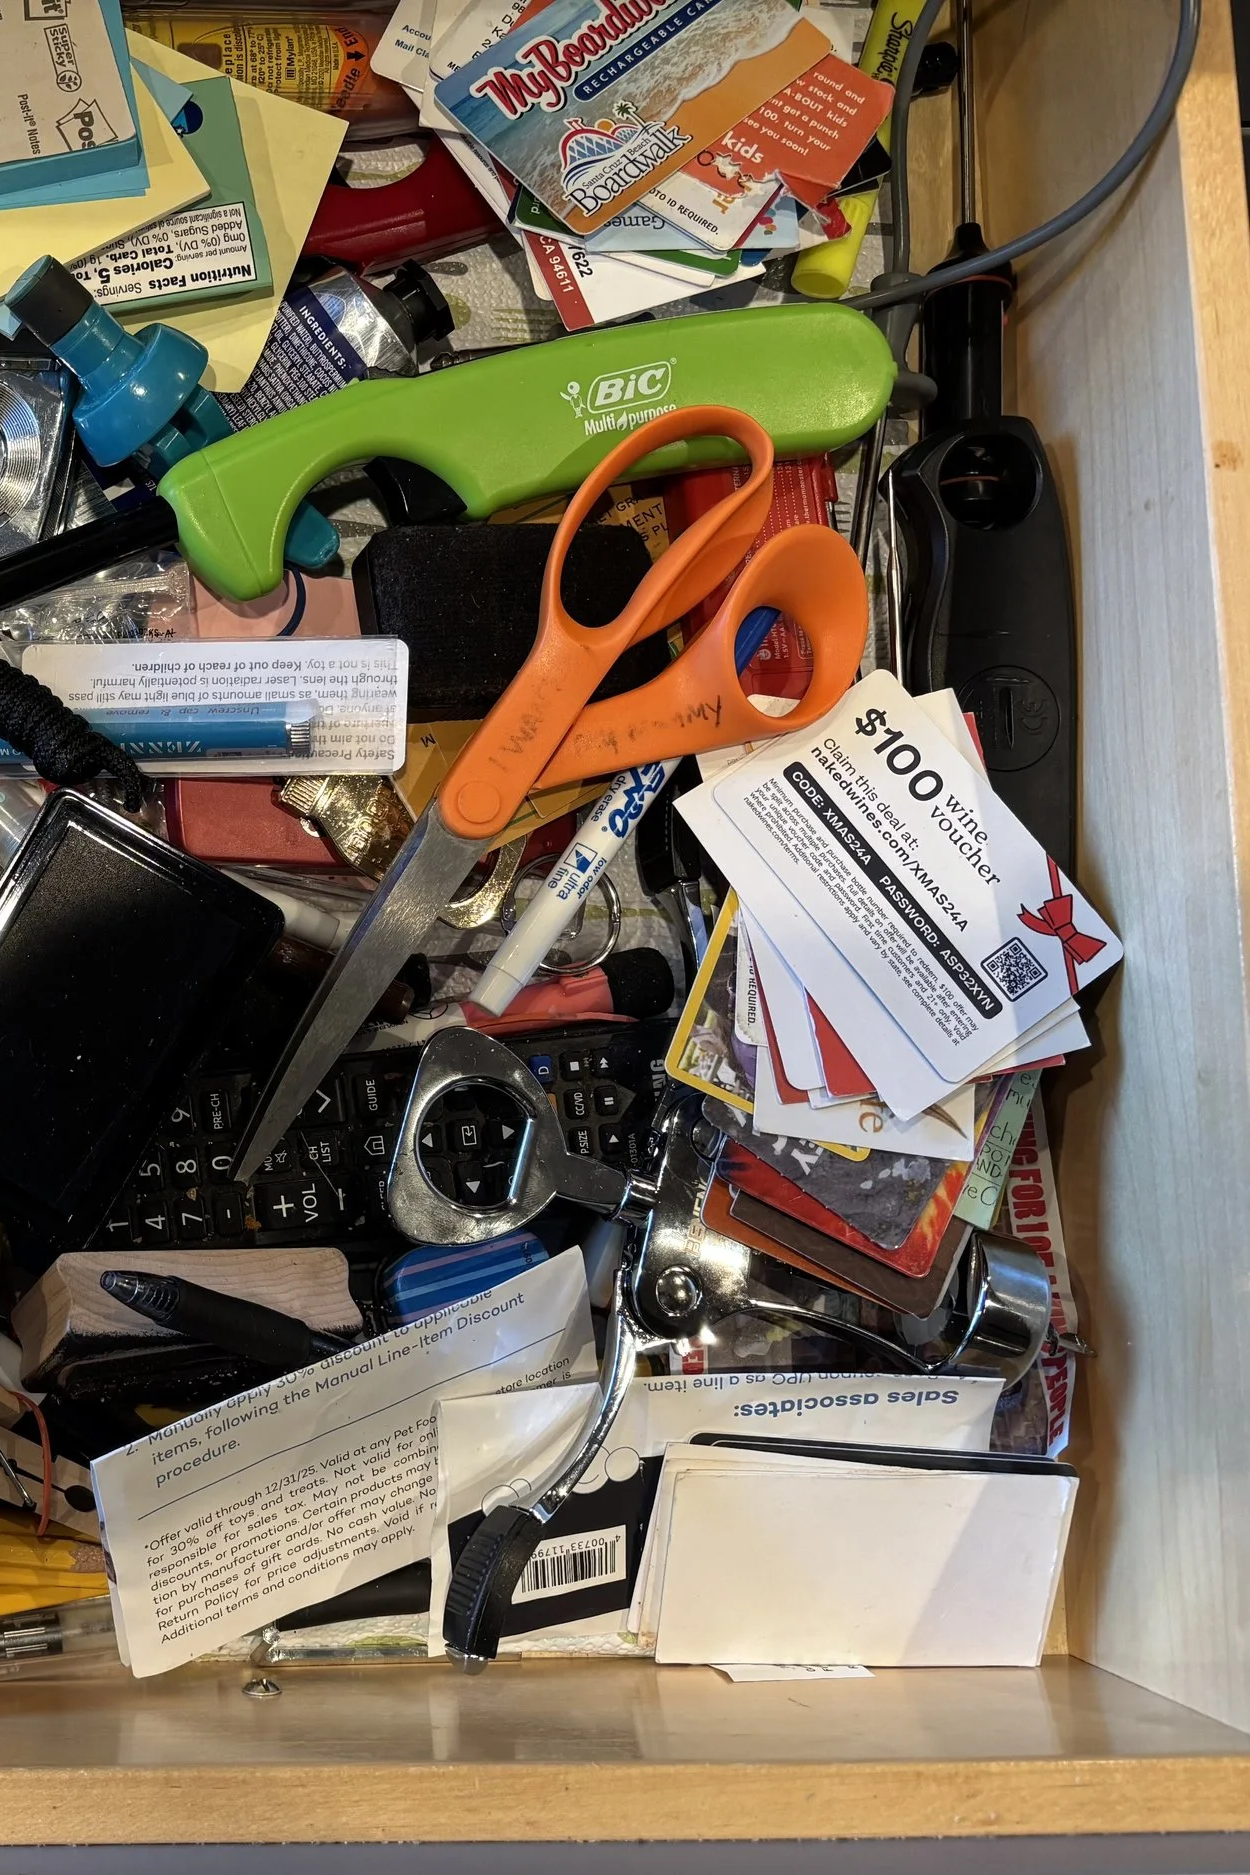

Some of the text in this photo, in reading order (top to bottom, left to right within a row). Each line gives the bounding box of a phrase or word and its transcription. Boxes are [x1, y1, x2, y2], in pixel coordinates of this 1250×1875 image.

[49, 27, 69, 70] Sticky
[54, 25, 77, 67] Super
[582, 17, 682, 93] RECHARGEABLE
[877, 11, 912, 74] Sharpie
[808, 85, 857, 115] stock and
[813, 71, 865, 104] round and
[26, 128, 40, 154] Notes
[720, 130, 765, 164] kids
[744, 117, 809, 155] see you soon!
[759, 106, 830, 150] 100, turn your
[569, 124, 689, 214] Boardwalk
[581, 137, 651, 189] Santa Cruz Beach
[666, 197, 718, 235] ID REQUIRED.
[93, 244, 247, 284] Amount per serving: Calories 5,
[93, 263, 251, 303] Nutrition Facts Servings:
[583, 412, 616, 436] Multi
[131, 659, 301, 673] Keep out of reach of children.
[853, 703, 947, 807] $100
[591, 772, 626, 821] dry erase
[823, 738, 918, 850] Claim this deal at:
[810, 741, 967, 932] nakedwines.com/XMAS24A
[945, 794, 987, 848] wine
[930, 803, 1000, 884] voucher
[541, 863, 569, 888] fine
[555, 869, 580, 900] ultra
[576, 855, 610, 901] low odor
[792, 771, 994, 1010] CODE: XMAS24A PASSWORD: ASP32XYN
[209, 1092, 223, 1129] PRE-CH
[365, 1078, 379, 1111] GUIDE
[573, 1091, 585, 1115] CC/VD
[308, 1145, 319, 1160] CH
[320, 1140, 331, 1162] LIST
[577, 1129, 589, 1154] P.SIZE
[301, 1182, 319, 1222] VOL
[1005, 1168, 1046, 1219] FOR
[151, 1292, 524, 1465] items, following the Manual Line-Item Discount
[732, 1387, 958, 1419] Sales associates:
[156, 1439, 240, 1488] procedure.
